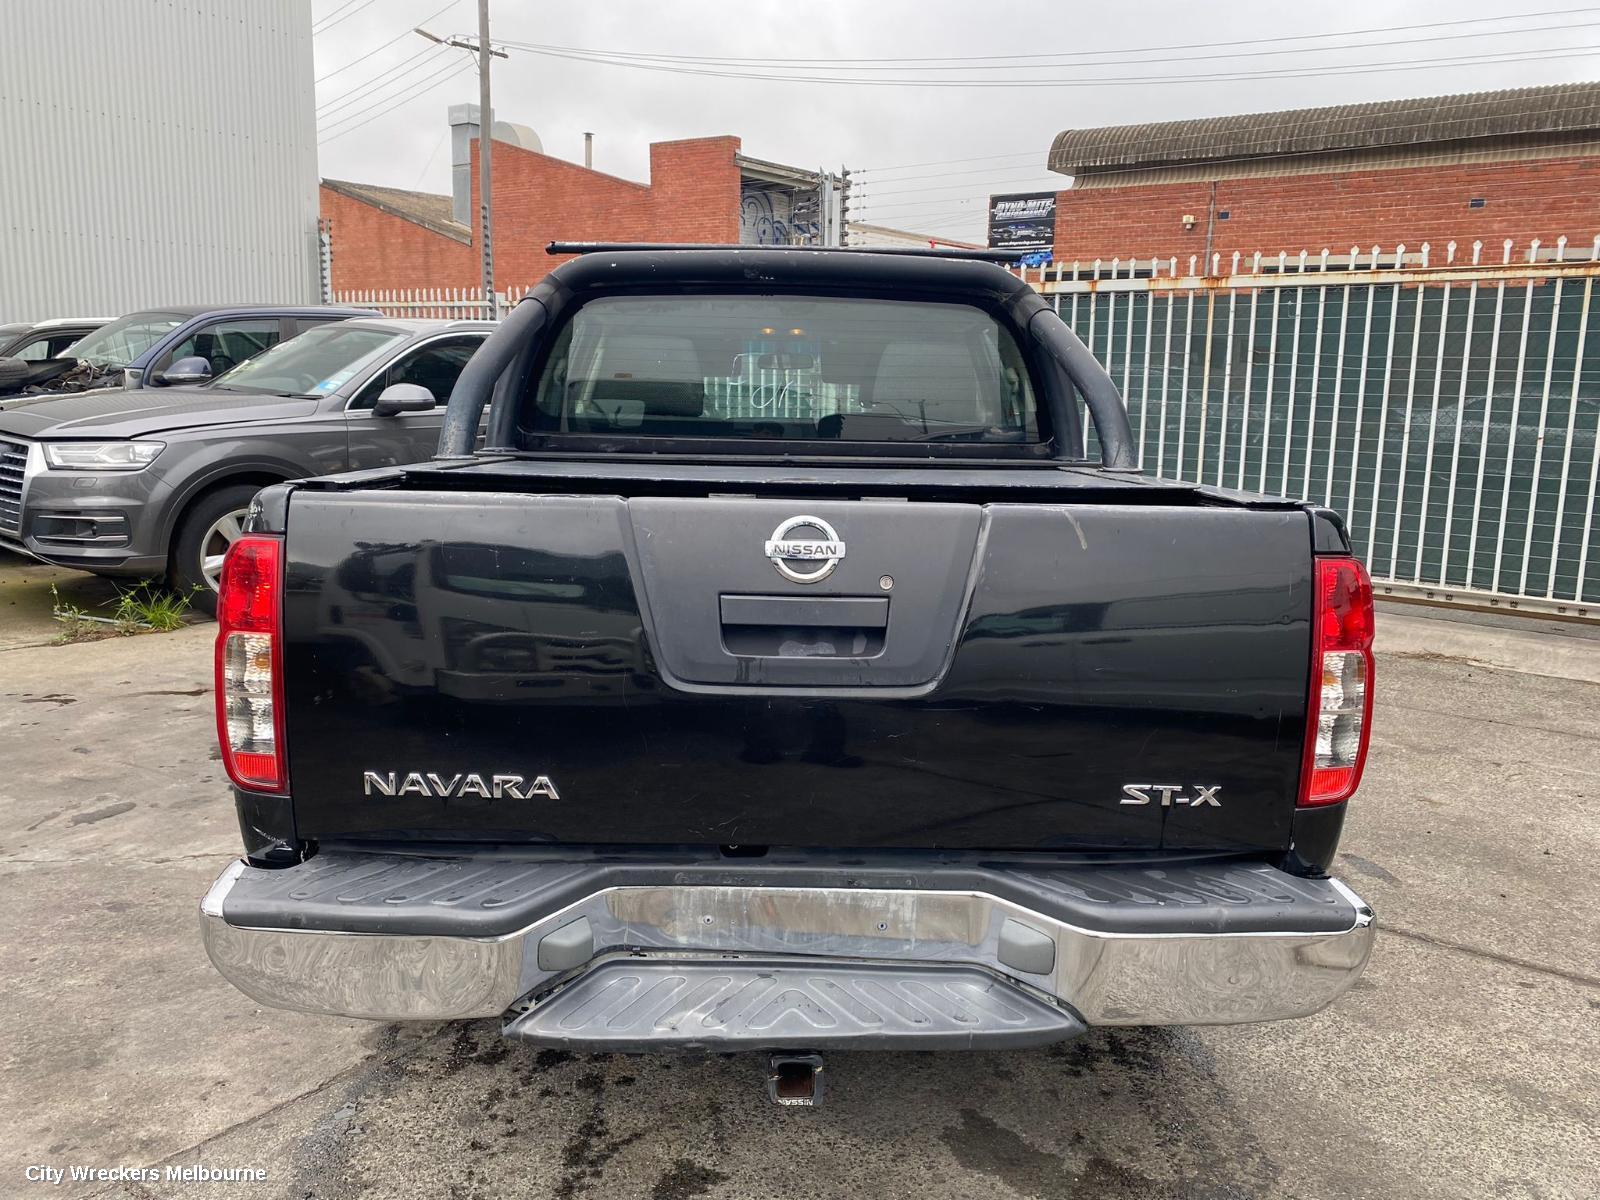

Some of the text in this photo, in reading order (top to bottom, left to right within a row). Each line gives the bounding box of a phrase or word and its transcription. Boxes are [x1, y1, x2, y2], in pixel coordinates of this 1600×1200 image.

[774, 544, 837, 556] NISSAN
[363, 771, 560, 800] NAVARA
[1120, 784, 1222, 807] ST-X
